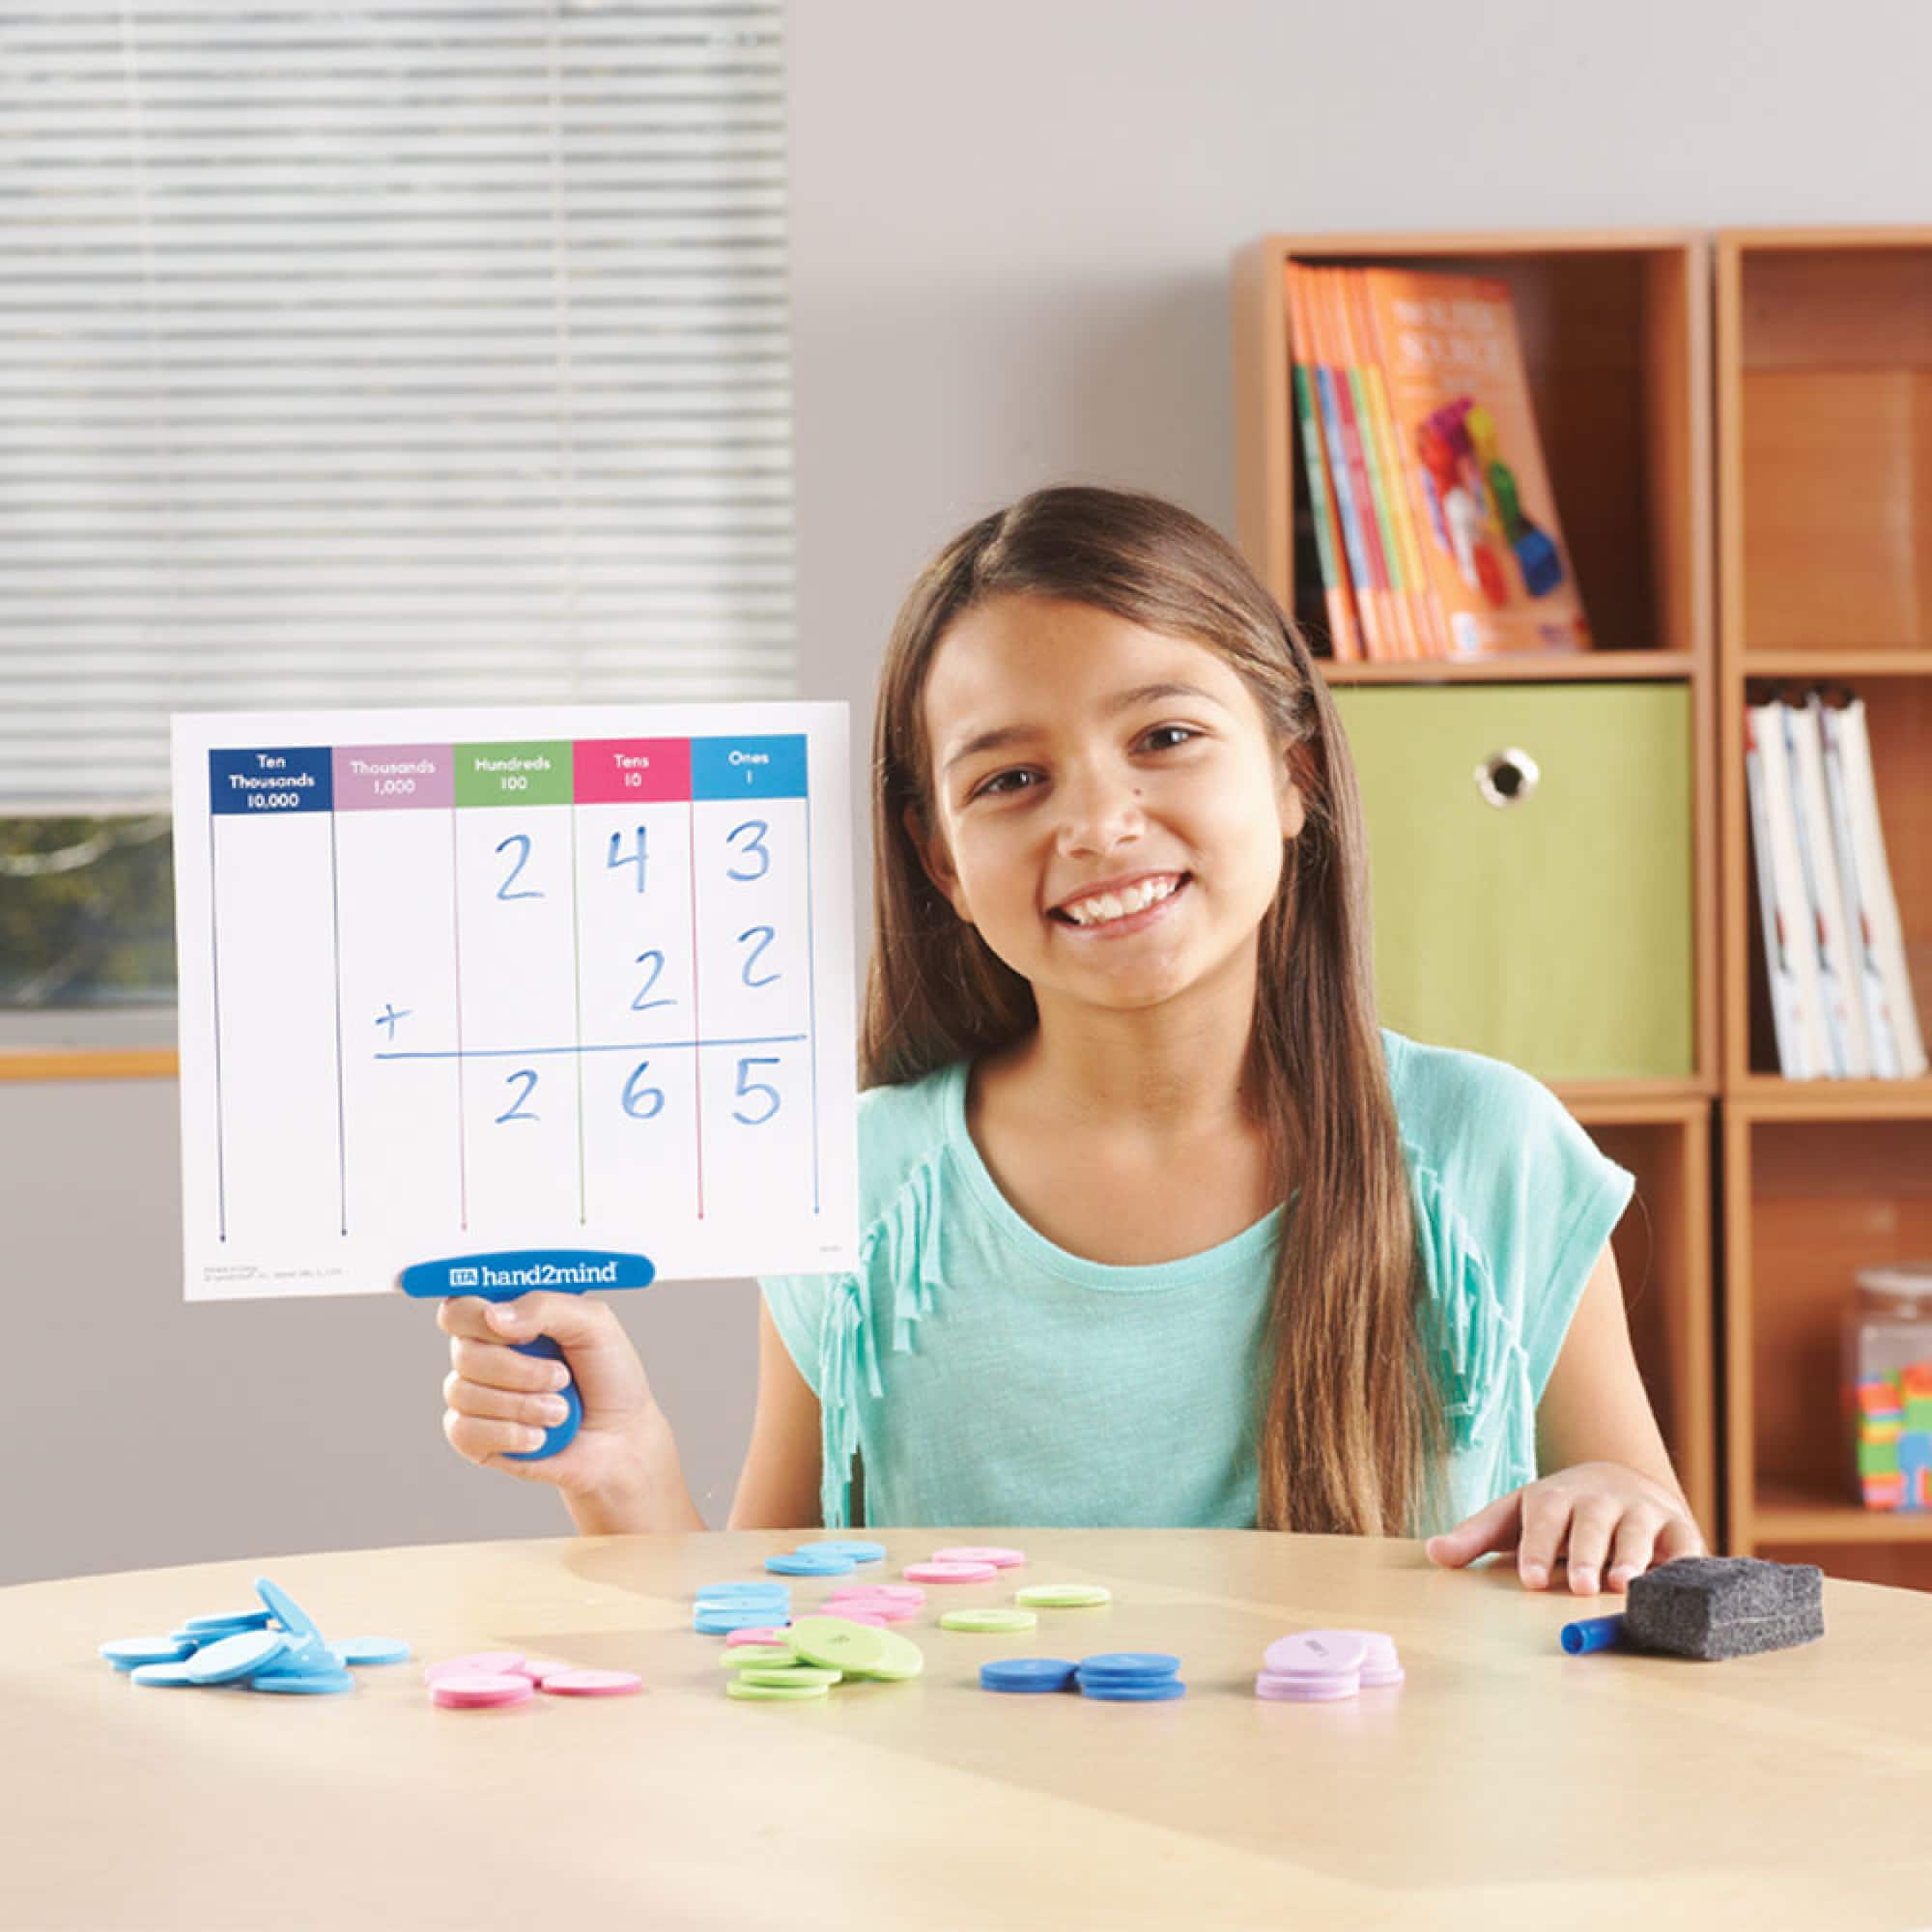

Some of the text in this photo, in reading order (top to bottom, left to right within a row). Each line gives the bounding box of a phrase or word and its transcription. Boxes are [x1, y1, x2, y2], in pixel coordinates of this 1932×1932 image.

[256, 753, 287, 769] Ten
[474, 756, 551, 772] Hundreds
[613, 753, 650, 769] Tens
[728, 750, 770, 765] Ones
[350, 759, 436, 775] Thousands
[228, 773, 315, 789] Thousands
[374, 780, 415, 795] 1,000
[501, 776, 527, 790] 100
[624, 772, 642, 787] 10
[247, 792, 299, 810] 10,000
[495, 819, 771, 901] 2 4 3
[630, 949, 678, 1011] 2
[737, 924, 781, 988] 2
[494, 1056, 781, 1126] 2 6 5
[482, 1262, 615, 1288] hand2mind
